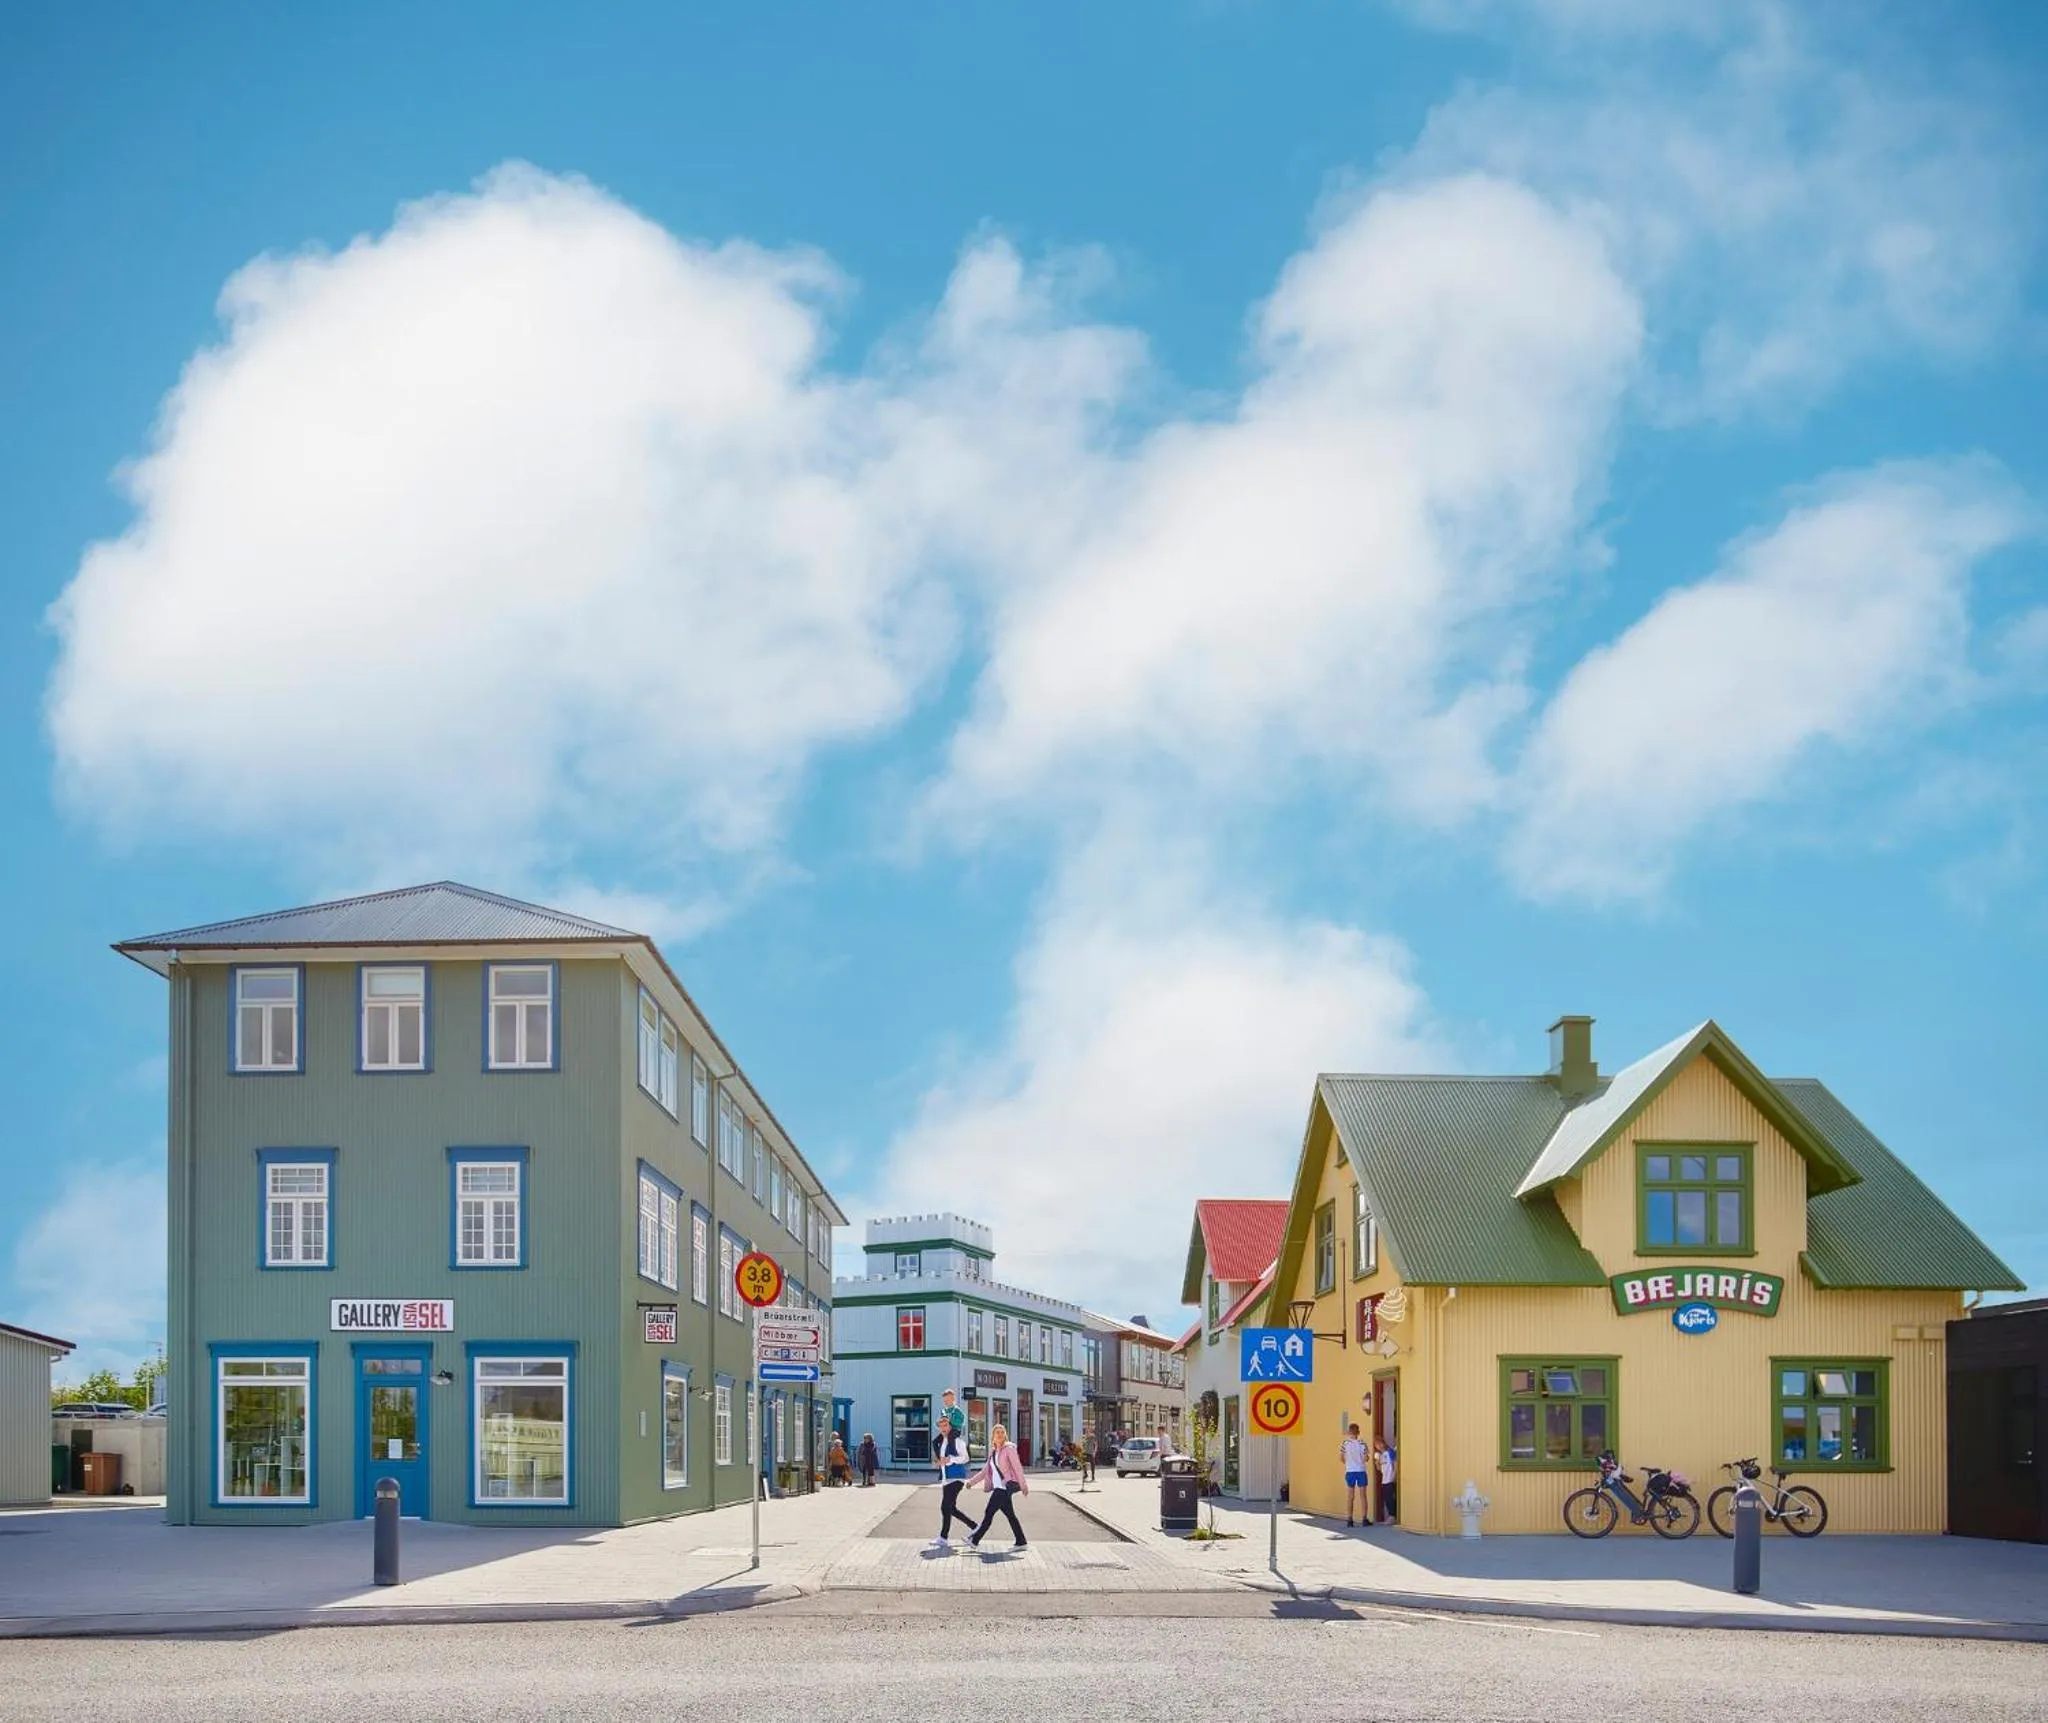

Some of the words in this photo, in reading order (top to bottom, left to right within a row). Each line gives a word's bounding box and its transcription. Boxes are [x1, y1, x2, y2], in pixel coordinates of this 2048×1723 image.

[747, 1266, 771, 1283] 3,8
[753, 1284, 764, 1293] m
[1624, 1273, 1773, 1306] BÆJARÍS
[339, 1304, 401, 1327] GALLERY
[403, 1303, 417, 1328] LISTA
[419, 1303, 447, 1328] SEL
[648, 1313, 674, 1323] GALLERY
[657, 1325, 674, 1340] SEL
[1264, 1398, 1289, 1418] 10
